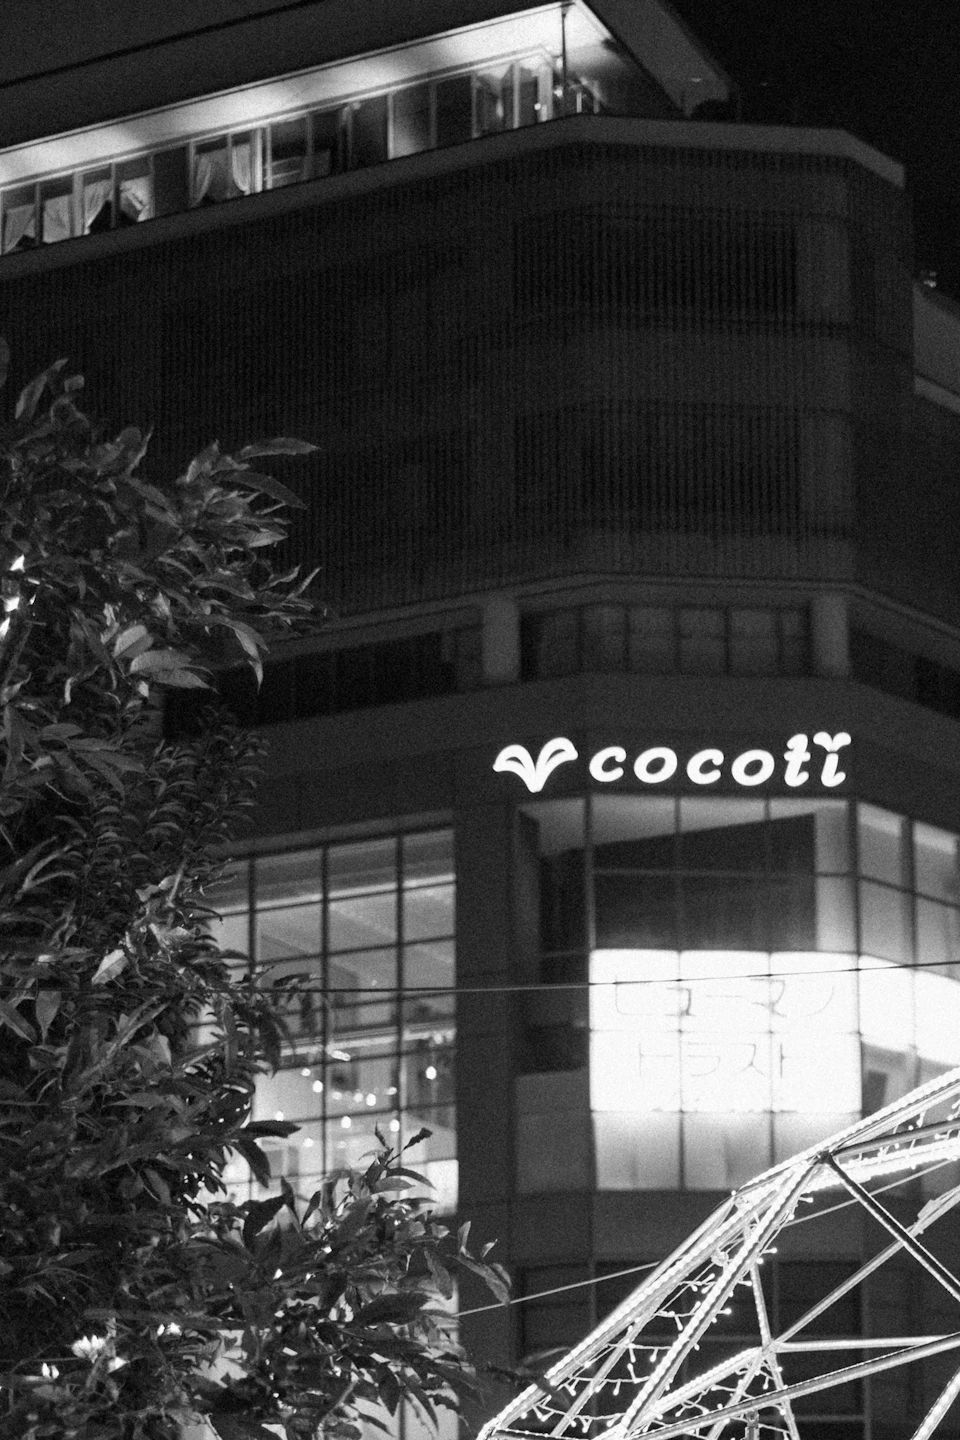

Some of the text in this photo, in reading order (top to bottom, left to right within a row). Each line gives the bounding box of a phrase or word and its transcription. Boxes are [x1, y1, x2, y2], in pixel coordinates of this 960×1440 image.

[588, 731, 852, 788] cocoti
[638, 1041, 806, 1078] トラスト
